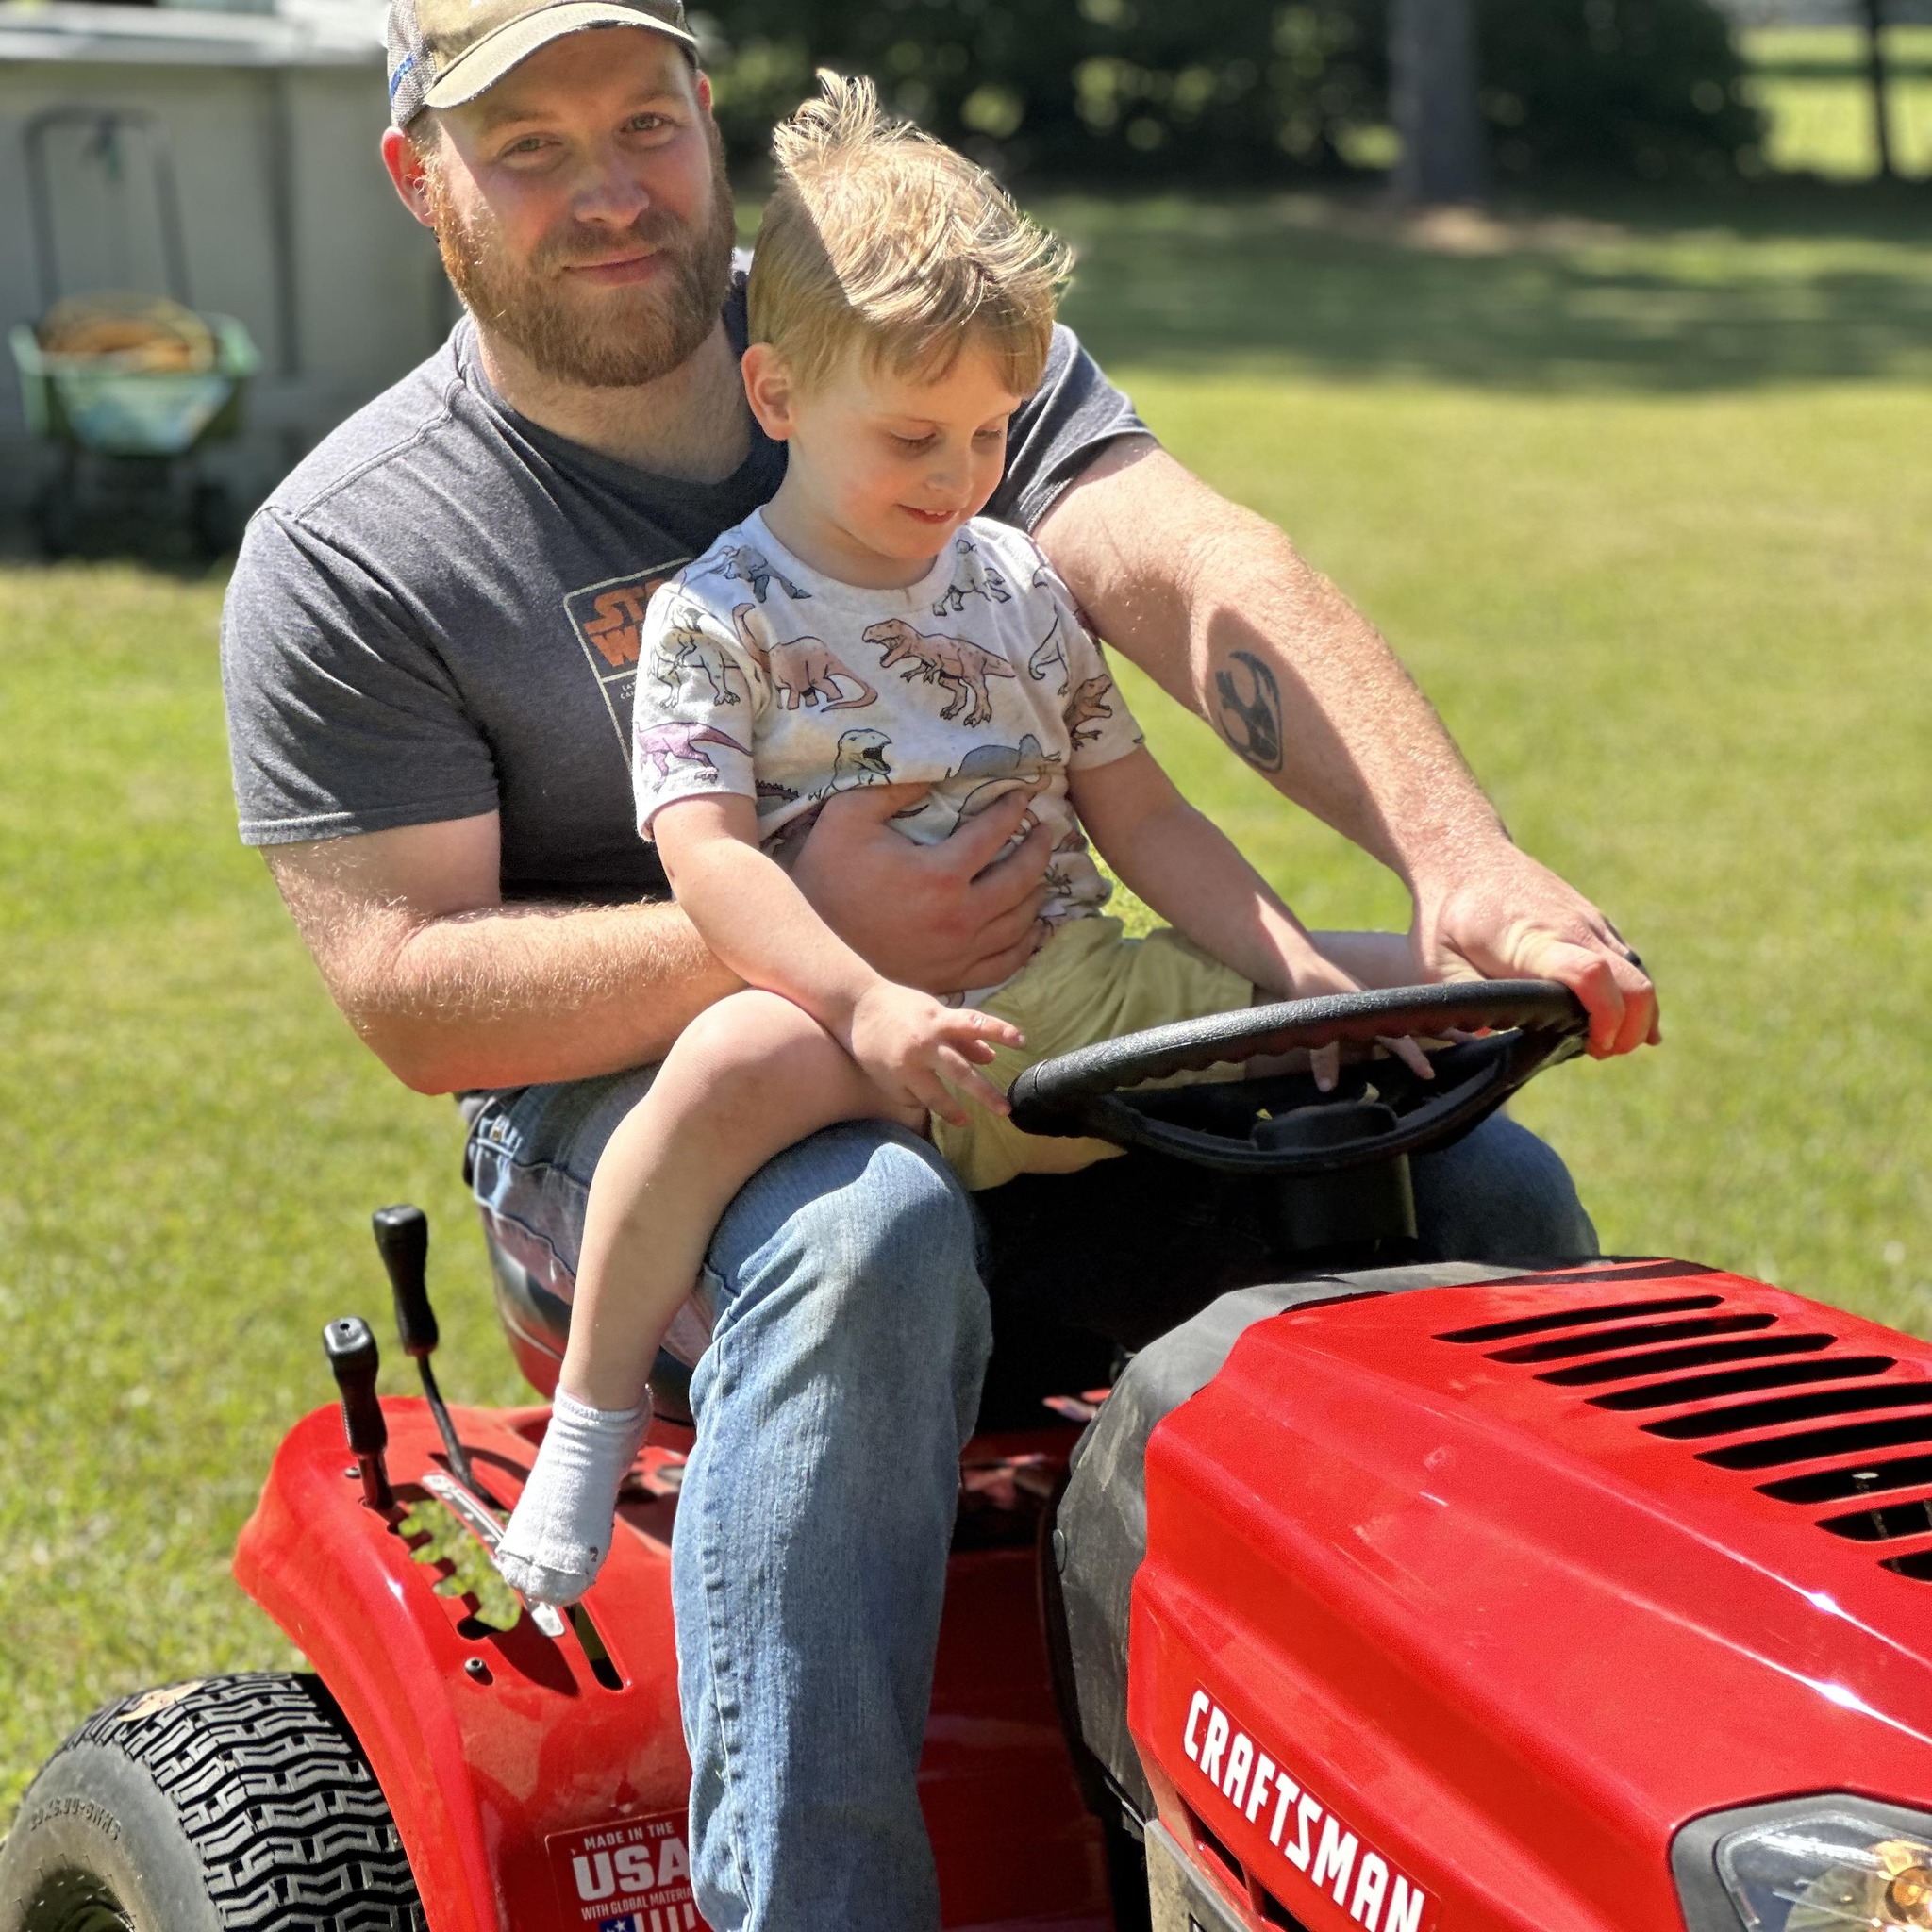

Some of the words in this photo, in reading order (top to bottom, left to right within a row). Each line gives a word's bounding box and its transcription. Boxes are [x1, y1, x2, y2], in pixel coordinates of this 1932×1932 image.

[1183, 1689, 1425, 1932] CRAFTSMAN
[583, 1833, 625, 1851] MADE
[628, 1826, 643, 1841] IN
[647, 1821, 675, 1839] THE
[572, 1837, 691, 1902] USA
[581, 1903, 609, 1921] WITH
[612, 1894, 649, 1916] GLOBAL
[649, 1887, 693, 1907] MATERIA
